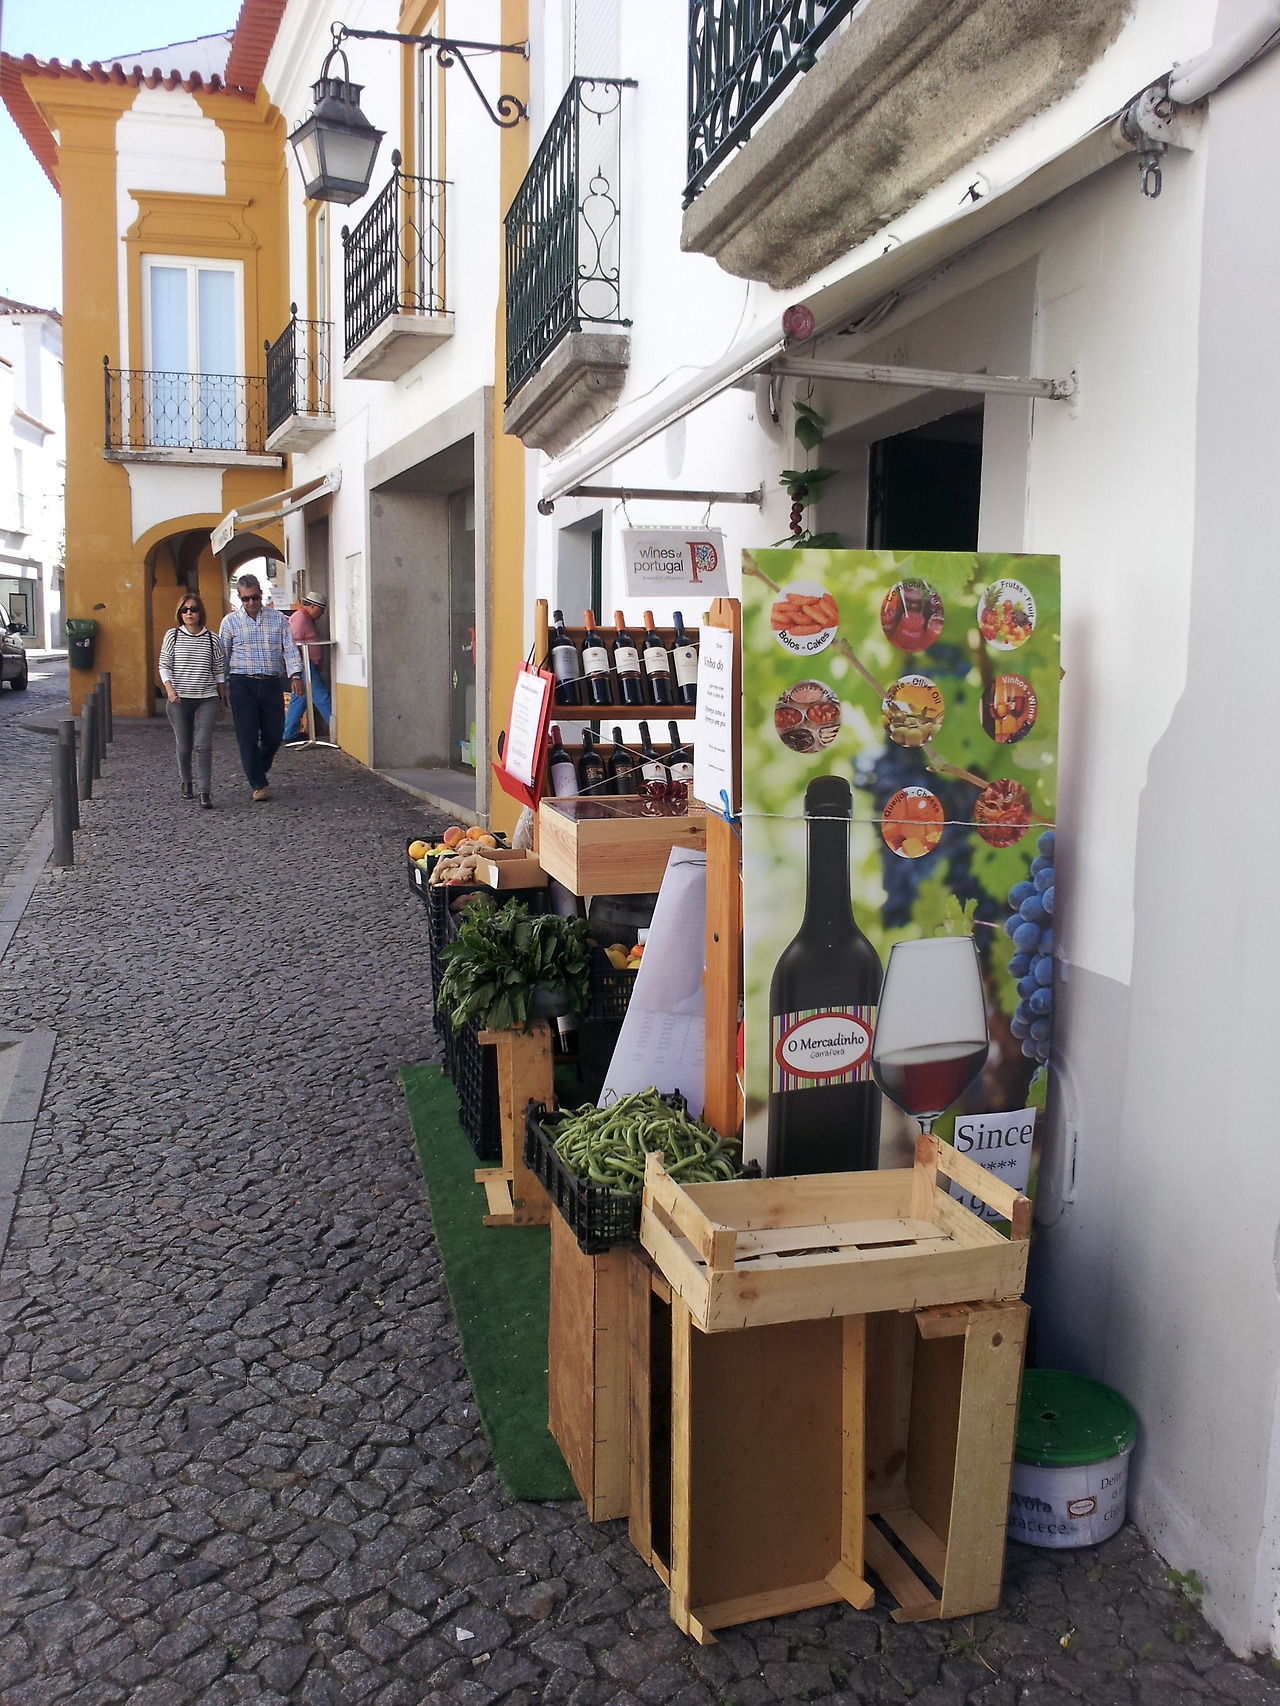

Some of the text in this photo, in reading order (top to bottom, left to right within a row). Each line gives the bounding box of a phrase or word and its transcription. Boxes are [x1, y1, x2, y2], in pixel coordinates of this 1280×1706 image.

[639, 546, 676, 559] wines
[633, 560, 684, 574] portugal
[1000, 580, 1024, 594] Frutas
[1025, 596, 1035, 618] Fruit
[778, 630, 800, 650] Bolos
[806, 631, 830, 651] Cakes
[912, 677, 933, 692] Olive
[931, 691, 942, 705] Oil
[1001, 675, 1028, 691] Vinhos
[884, 790, 909, 818] Queijos
[916, 788, 940, 814] Cheese
[787, 1031, 865, 1052] O Mercadinho
[956, 1123, 1033, 1153] Since
